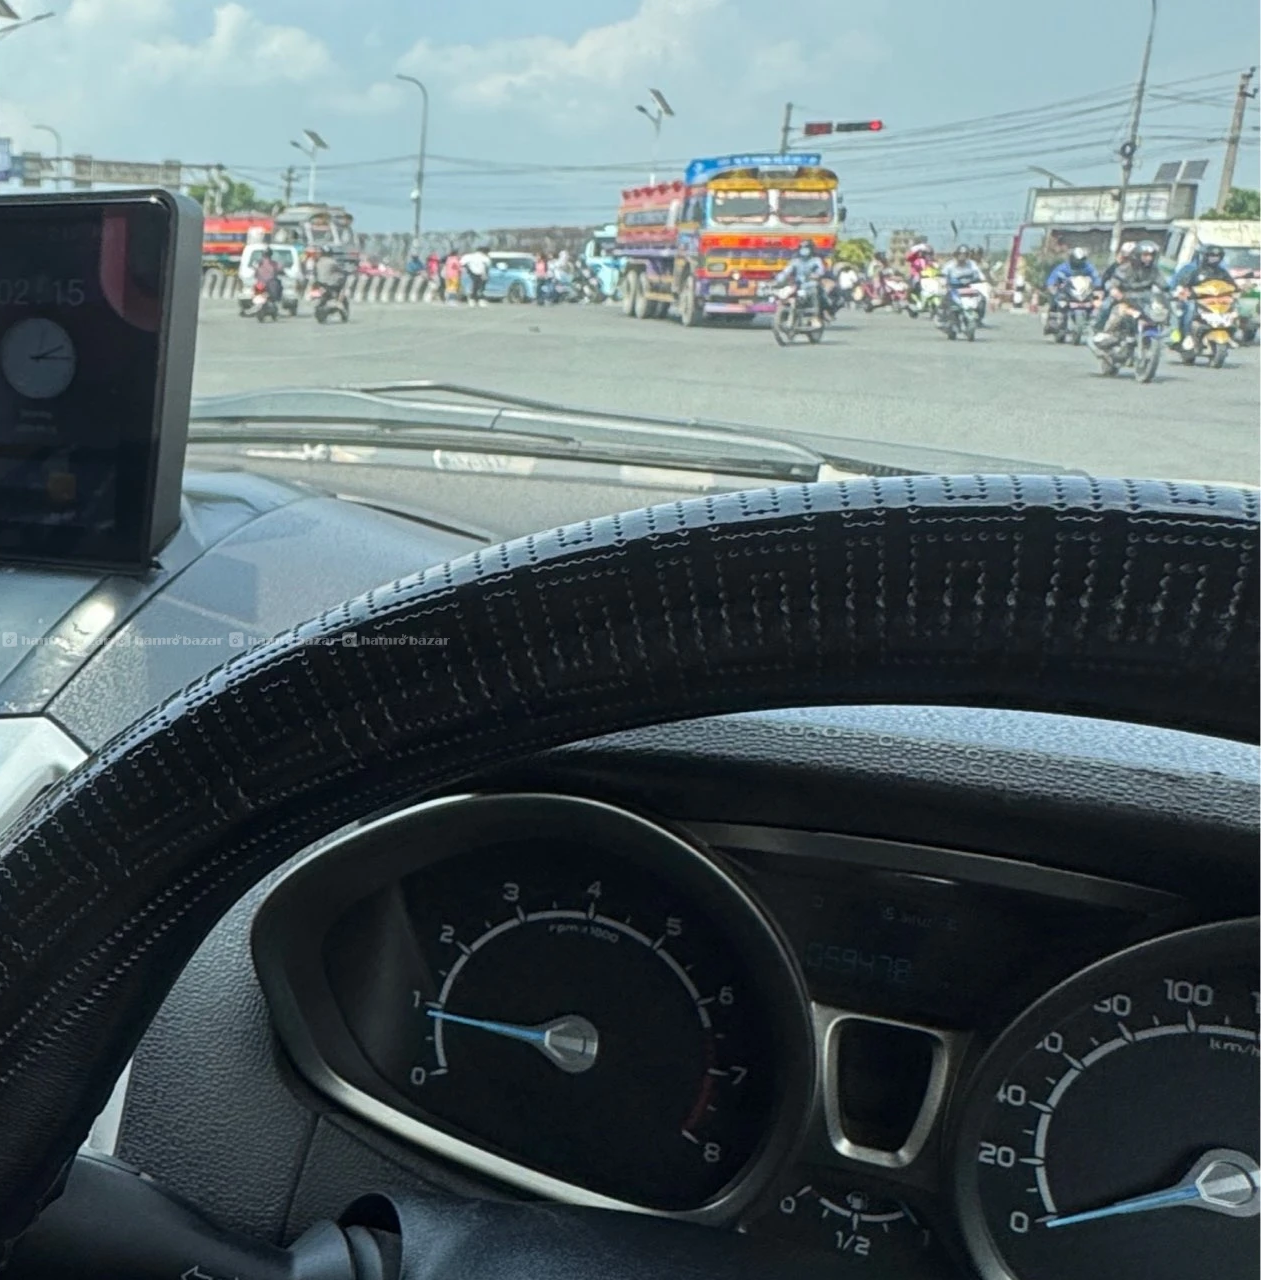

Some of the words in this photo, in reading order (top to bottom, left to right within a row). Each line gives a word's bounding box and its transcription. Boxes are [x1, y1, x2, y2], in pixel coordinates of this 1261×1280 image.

[503, 883, 520, 901] 3
[588, 881, 602, 899] 4
[440, 924, 455, 943] 2
[666, 917, 682, 936] 5
[413, 991, 421, 1008] 1
[719, 986, 734, 1005] 6
[1163, 978, 1214, 1007] 100
[1035, 1031, 1063, 1054] 0
[410, 1067, 426, 1085] 0
[730, 1066, 748, 1085] 7
[703, 1142, 721, 1163] 8
[978, 1141, 1016, 1168] 20
[780, 1196, 796, 1214] 0
[1009, 1211, 1029, 1233] 0
[835, 1230, 871, 1256] 1/2
